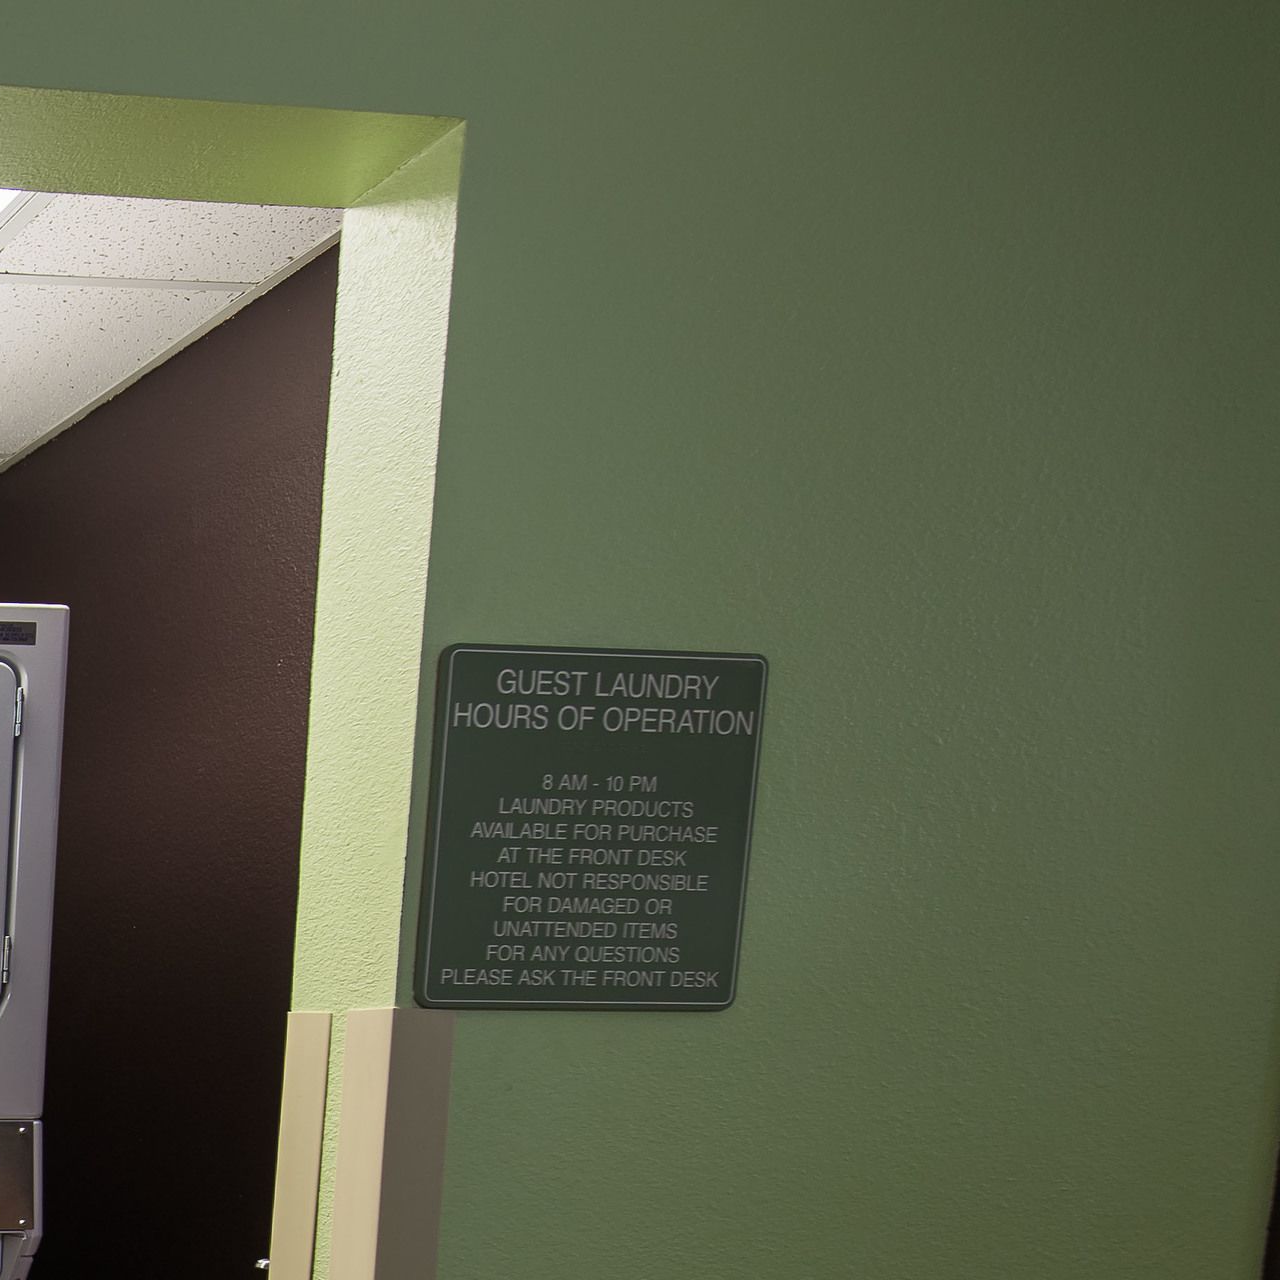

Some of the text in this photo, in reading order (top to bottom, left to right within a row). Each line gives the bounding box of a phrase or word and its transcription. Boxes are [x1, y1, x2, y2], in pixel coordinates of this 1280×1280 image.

[497, 669, 719, 700] GUEST LAUNDRY
[453, 703, 754, 735] HOURS OF OPERATION
[542, 774, 553, 790] 8
[558, 775, 587, 791] AM
[606, 776, 623, 791] 10
[629, 776, 657, 792] PM
[499, 798, 694, 818] LAUNDRY PRODUCTS
[470, 822, 719, 843] AVAILABLE FOR PURCHASE
[497, 847, 687, 866] AT THE FRONT DESK
[470, 872, 709, 891] HOTEL NOT RESPONSIBLE
[503, 897, 672, 915] FOR DAMAGED OR
[493, 921, 678, 939] UNATTENDED ITEMS
[486, 946, 680, 963] FOR ANY QUESTIONS
[441, 969, 719, 988] PLEASE ASK THE FRONT DESK
